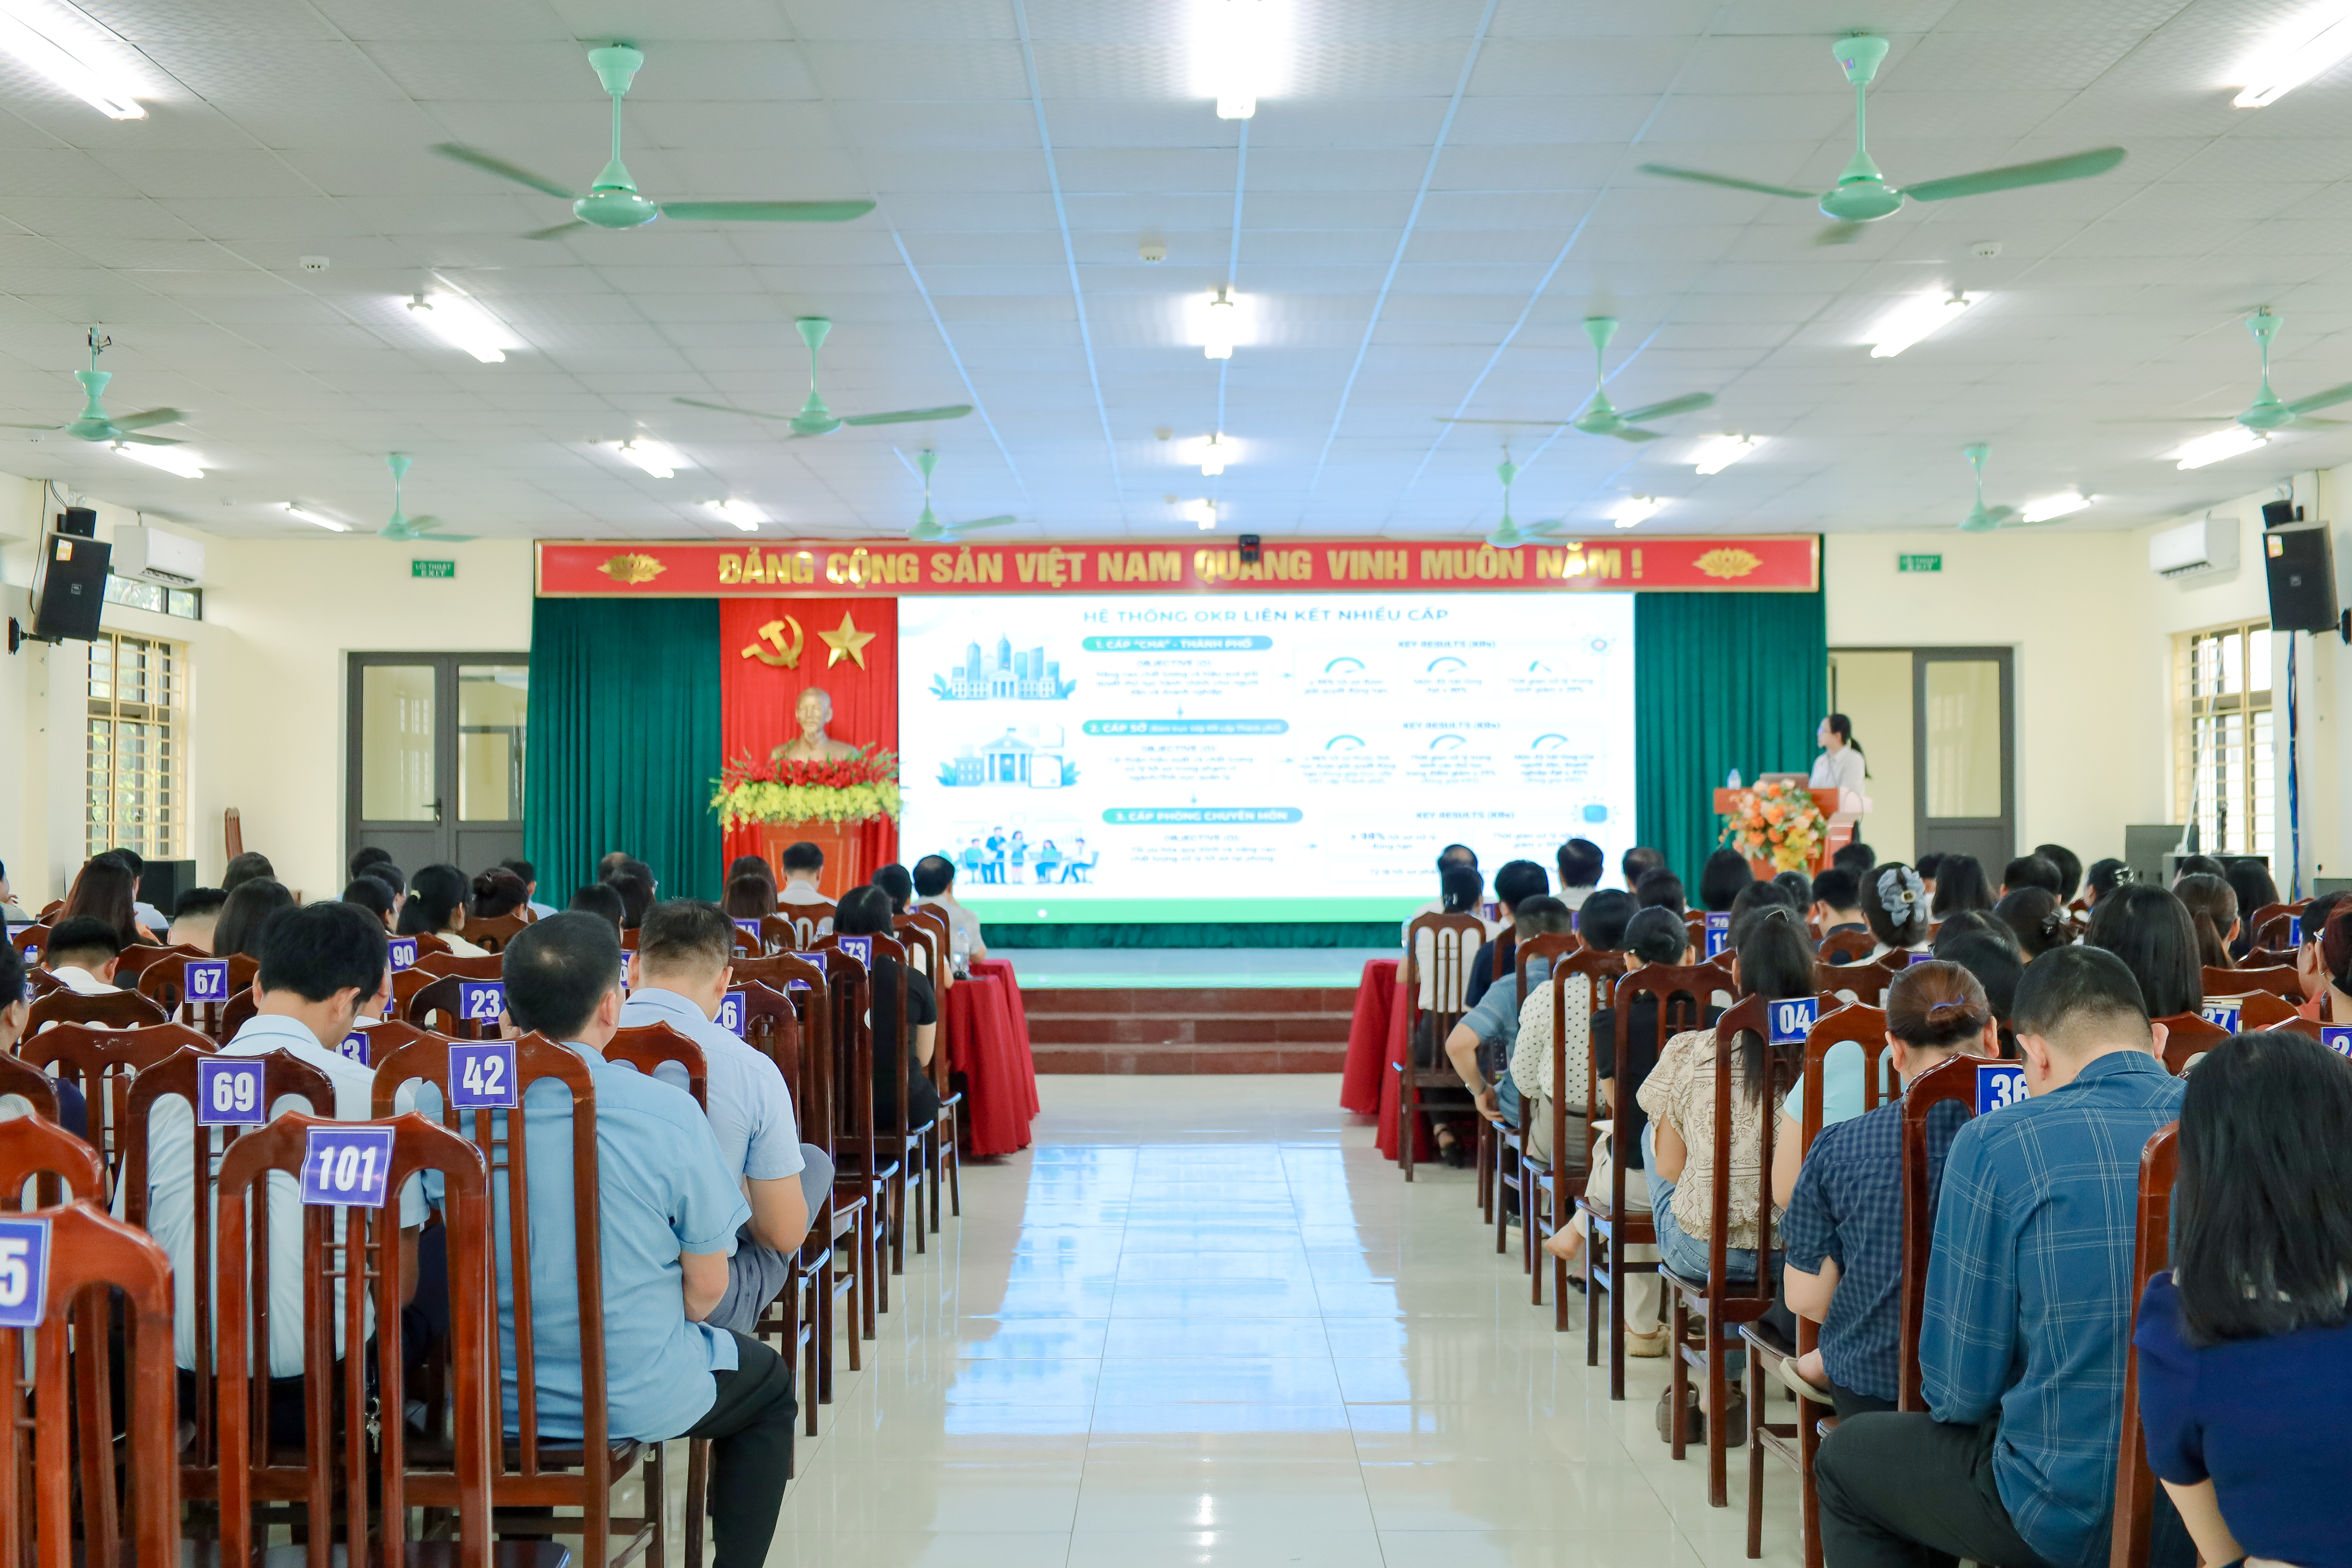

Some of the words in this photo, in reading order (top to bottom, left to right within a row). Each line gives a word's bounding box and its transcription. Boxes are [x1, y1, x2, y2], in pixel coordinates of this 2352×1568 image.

[718, 547, 814, 584] ĐẢNG
[826, 547, 919, 588] CỘNG
[931, 546, 1003, 583] SẢN
[1015, 547, 1086, 588] VIỆT
[1098, 552, 1182, 582] NAM
[1327, 550, 1407, 580] VINH
[1421, 543, 1524, 580] MUÔN
[1536, 542, 1621, 579] NĂM
[1084, 608, 1109, 625] HỆ
[1117, 607, 1188, 622] THỐNG
[1194, 611, 1237, 622] OKR
[1243, 608, 1288, 622] LIÊN
[1294, 607, 1331, 621] KẾT
[1338, 606, 1401, 621] NHIỀU
[1407, 606, 1449, 621] CẤP
[1095, 639, 1104, 649] 1.
[1106, 639, 1132, 649] CẤP
[1180, 639, 1223, 648] THÀNH
[1103, 723, 1126, 733] CẤP
[1115, 811, 1126, 822] 3.
[1128, 810, 1154, 821] CẤP
[1257, 810, 1288, 820] MÔN
[393, 945, 414, 966] 90
[845, 942, 866, 962] 73
[193, 969, 221, 994] 67
[620, 959, 628, 982] 6
[470, 989, 501, 1018] 23
[718, 1001, 737, 1030] 6
[1779, 1004, 1811, 1034] 04
[2202, 1008, 2231, 1028] 37
[2332, 1035, 2352, 1058] 2
[462, 1055, 505, 1096] 42
[213, 1072, 254, 1112] 69
[1991, 1073, 2030, 1110] 36
[319, 1145, 377, 1192] 101
